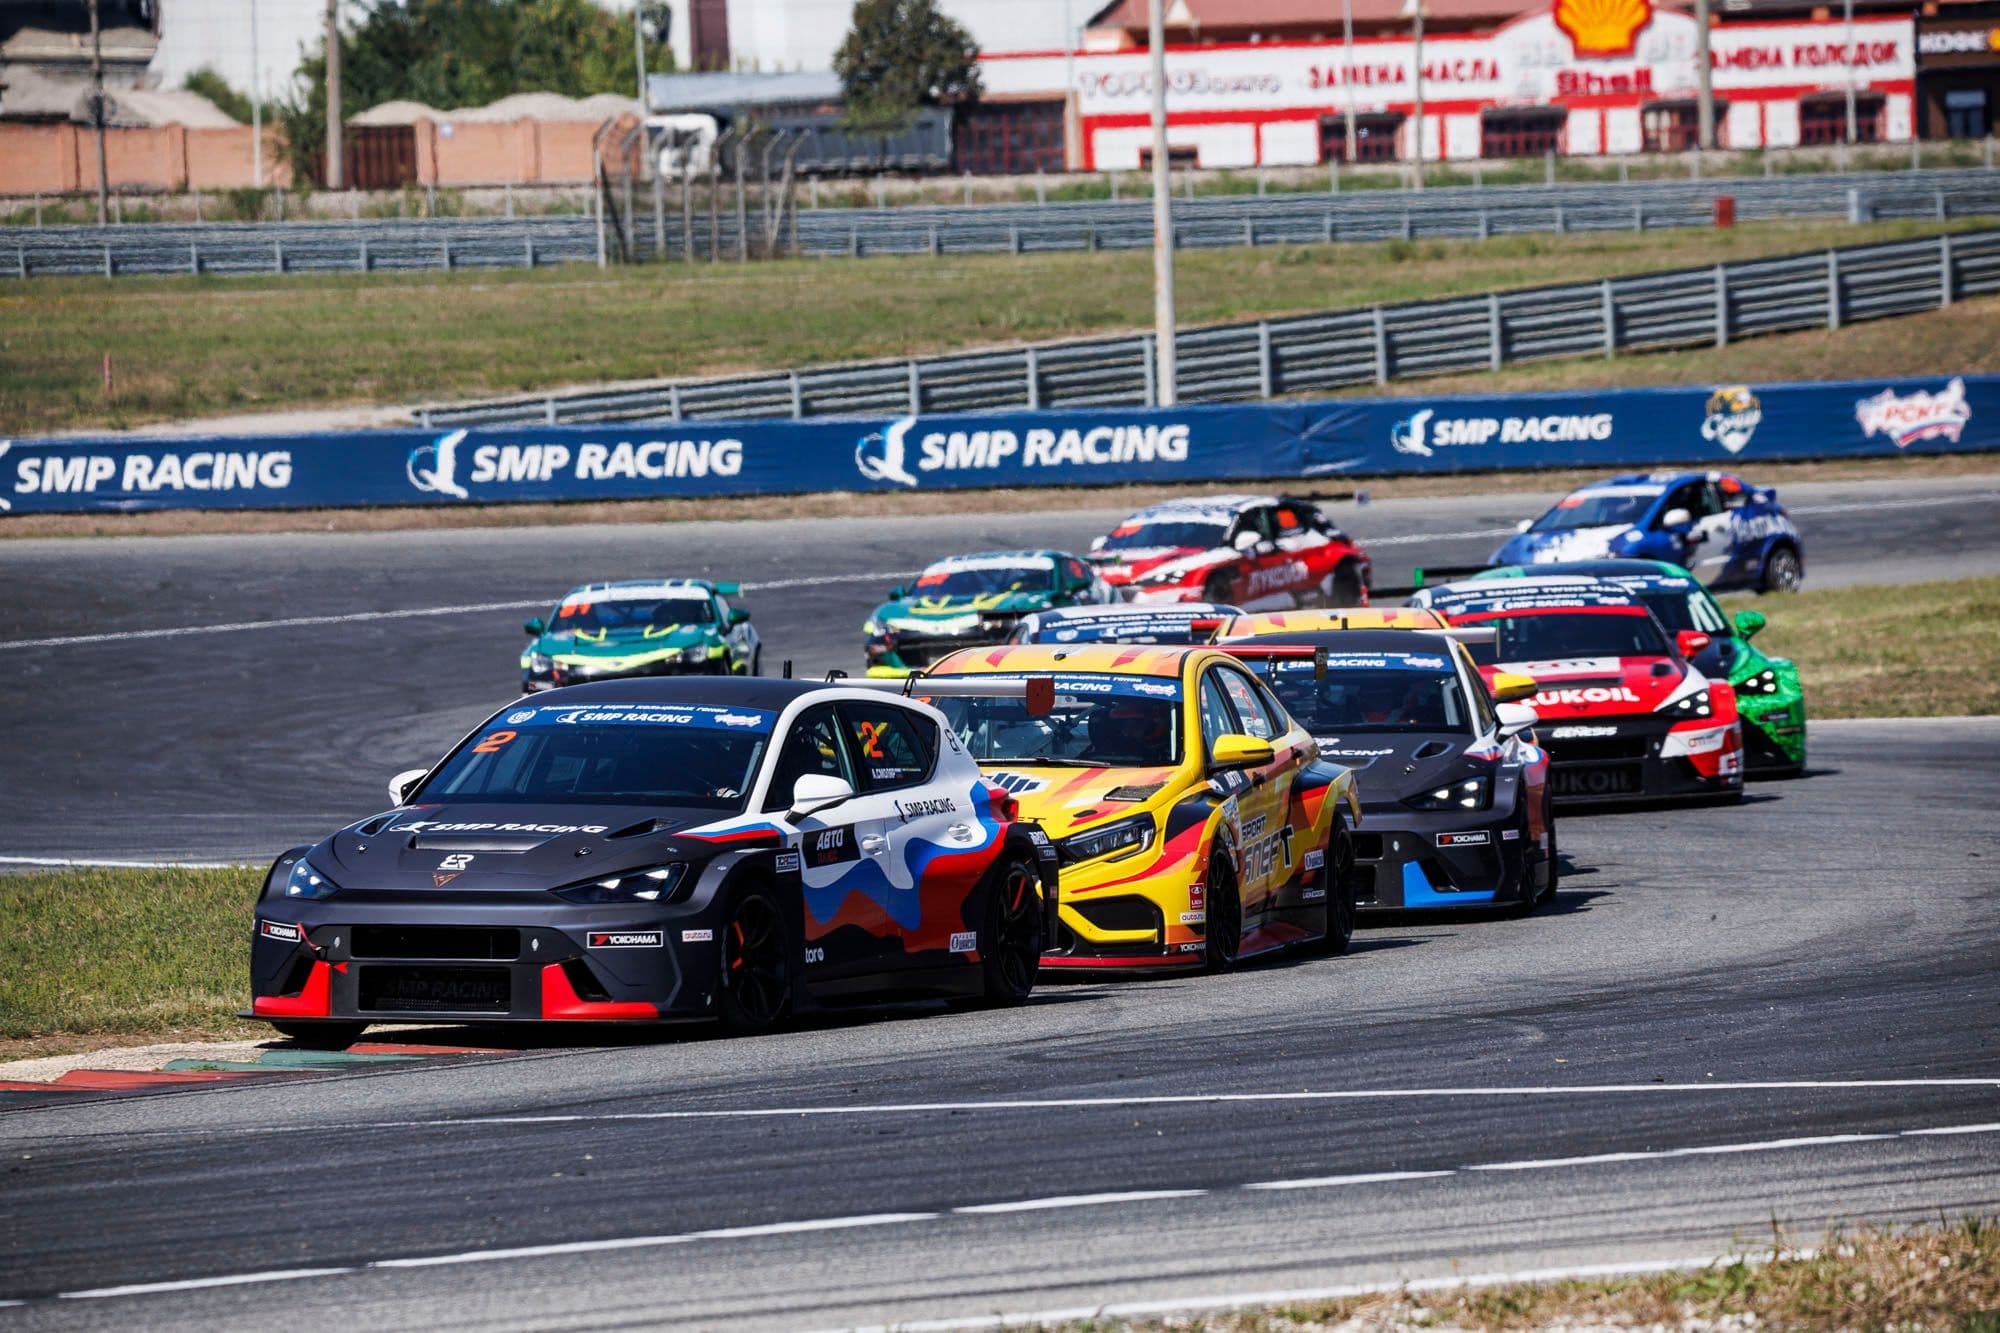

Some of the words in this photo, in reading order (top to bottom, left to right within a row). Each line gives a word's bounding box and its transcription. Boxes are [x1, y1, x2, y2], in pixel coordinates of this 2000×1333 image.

[1918, 32, 1985, 52] КОФЕ
[1694, 47, 1783, 70] АМЕНА
[1309, 64, 1405, 89] ЗАМЕНА
[1557, 69, 1652, 95] Shell
[1433, 418, 1499, 446] SMP
[1501, 413, 1613, 443] RACING
[918, 430, 1018, 471] SMP
[1023, 424, 1190, 467] RACING
[14, 456, 114, 493] SMP
[121, 450, 293, 491] RACING
[470, 445, 571, 482] SMP
[575, 440, 743, 479] RACING
[1148, 625, 1189, 633] RACIN
[1287, 660, 1315, 668] SM
[1327, 659, 1386, 668] RACING
[579, 712, 627, 722] SMP
[624, 712, 694, 724] RACING
[471, 730, 518, 753] 2
[861, 721, 884, 758] 2
[1551, 770, 1633, 793] UKOIL
[904, 801, 924, 818] SMP
[923, 797, 956, 816] RACING
[424, 822, 489, 832] SMP
[492, 822, 609, 834] RACING
[816, 828, 844, 851] АВТО
[1241, 813, 1266, 843] SPORT
[1452, 832, 1487, 844] YOKOHAMA
[269, 925, 297, 938] YOKOHAMA
[608, 934, 657, 945] YOKOHAMA
[805, 947, 825, 963] toro
